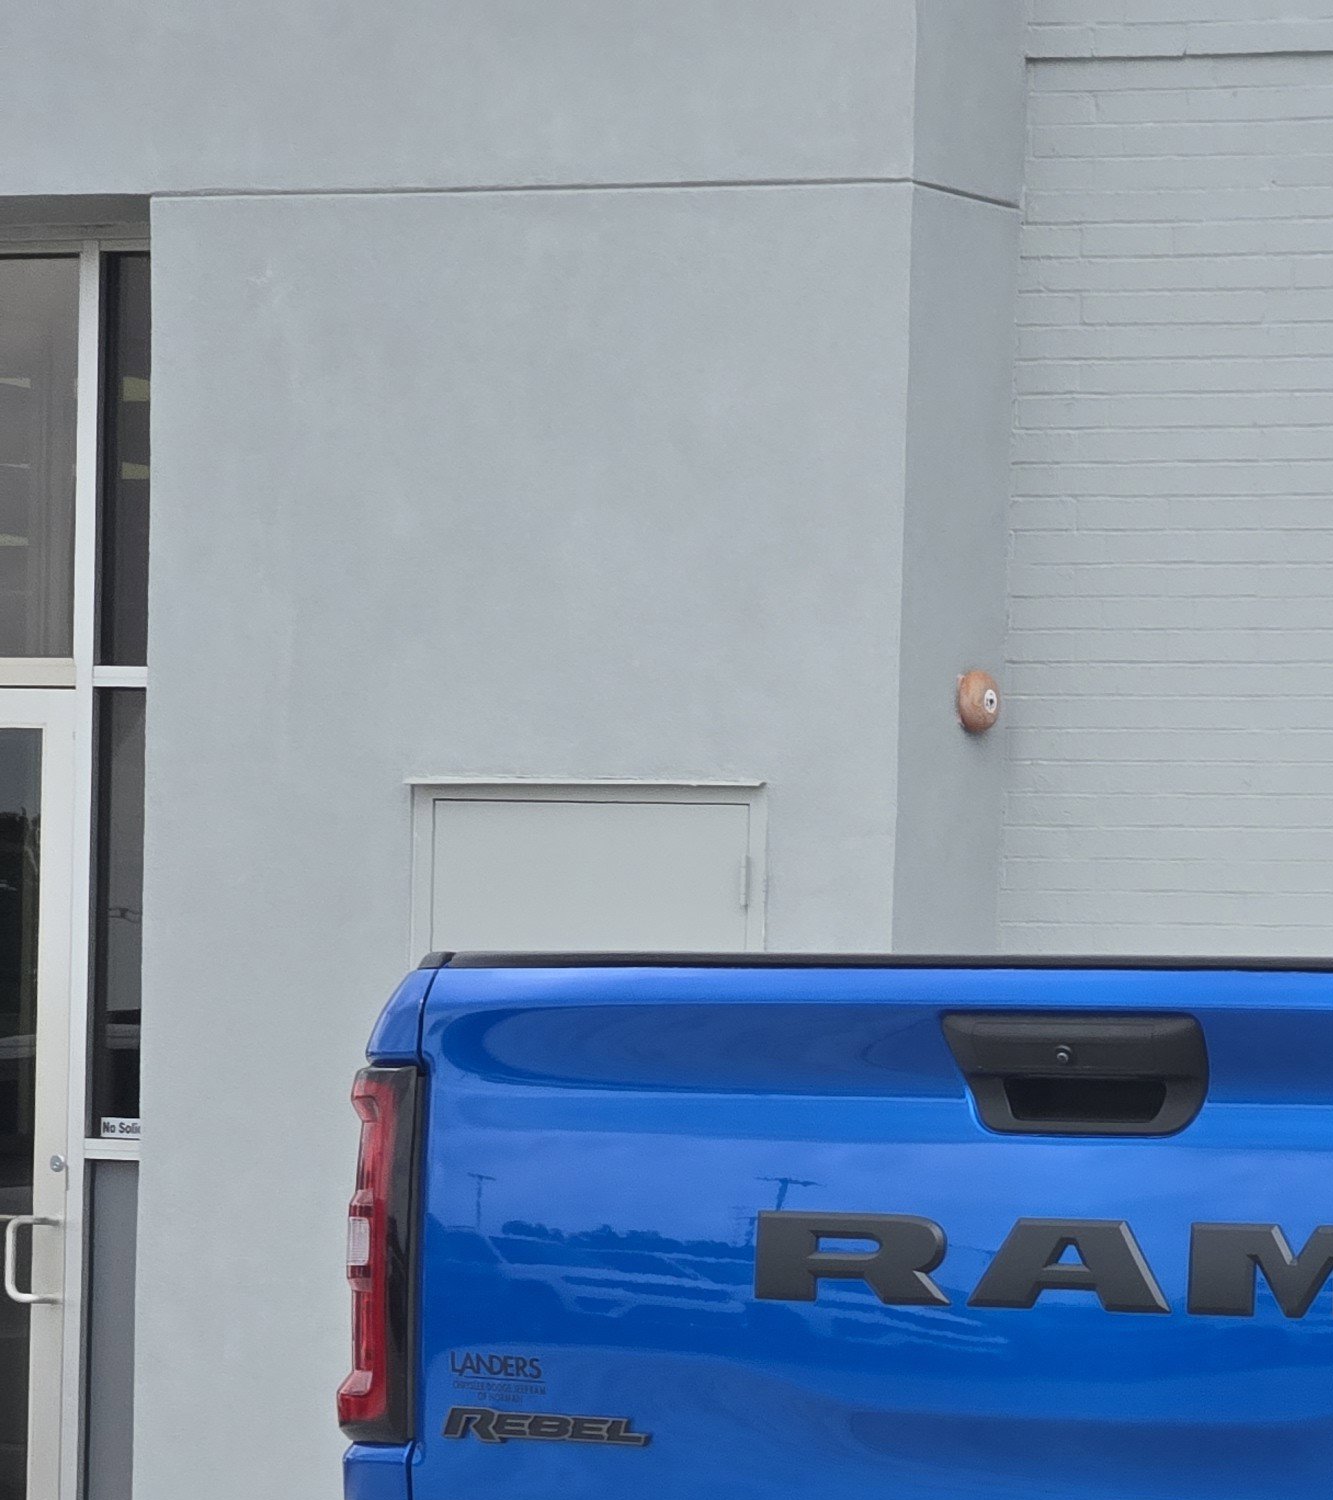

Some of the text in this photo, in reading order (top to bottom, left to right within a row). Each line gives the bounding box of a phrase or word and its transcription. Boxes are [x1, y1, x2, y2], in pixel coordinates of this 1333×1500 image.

[102, 1121, 116, 1134] No
[450, 1350, 543, 1380] LANDERS
[443, 1405, 651, 1447] REBEL
